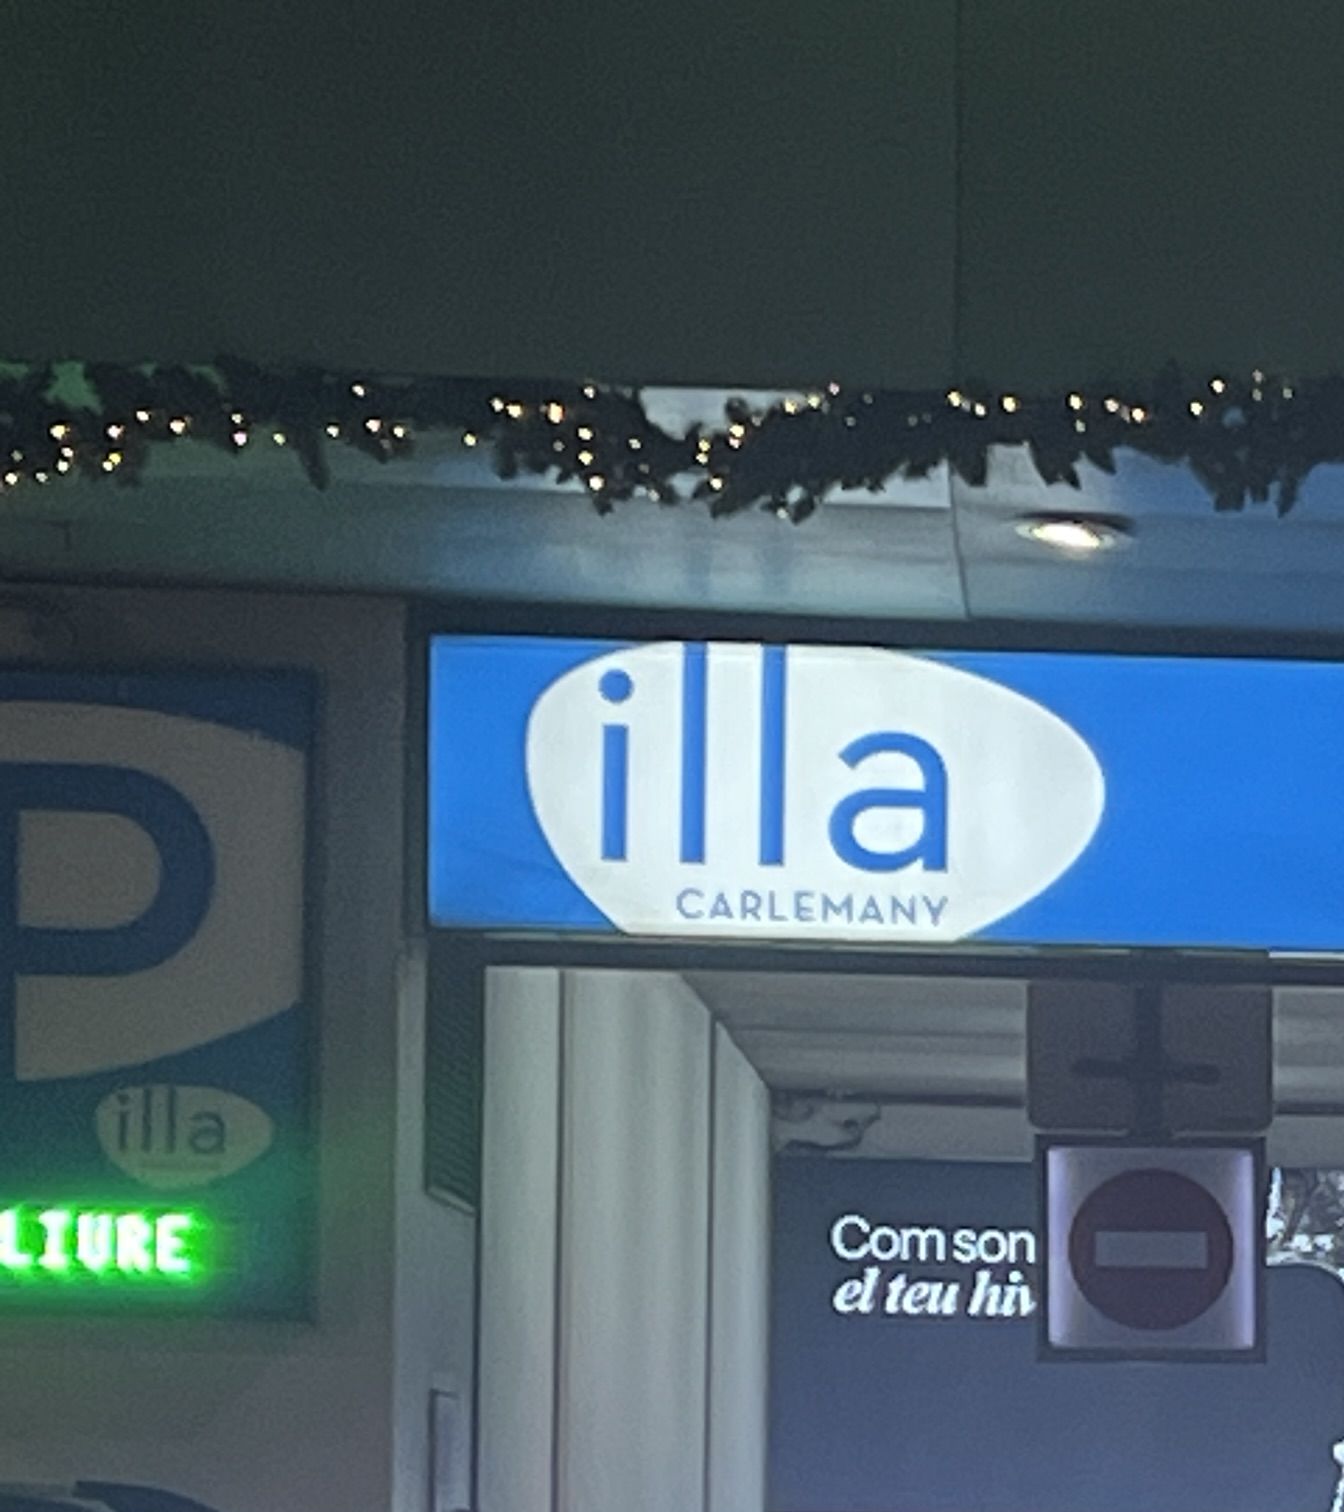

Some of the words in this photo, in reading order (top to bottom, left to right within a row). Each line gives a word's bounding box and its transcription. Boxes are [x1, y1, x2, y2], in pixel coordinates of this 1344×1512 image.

[597, 642, 950, 873] illa
[675, 888, 950, 927] CARLEMANY
[113, 1084, 228, 1156] illa
[830, 1213, 946, 1262] Com
[951, 1227, 1036, 1264] son
[832, 1265, 881, 1315] el
[884, 1272, 961, 1316] teu
